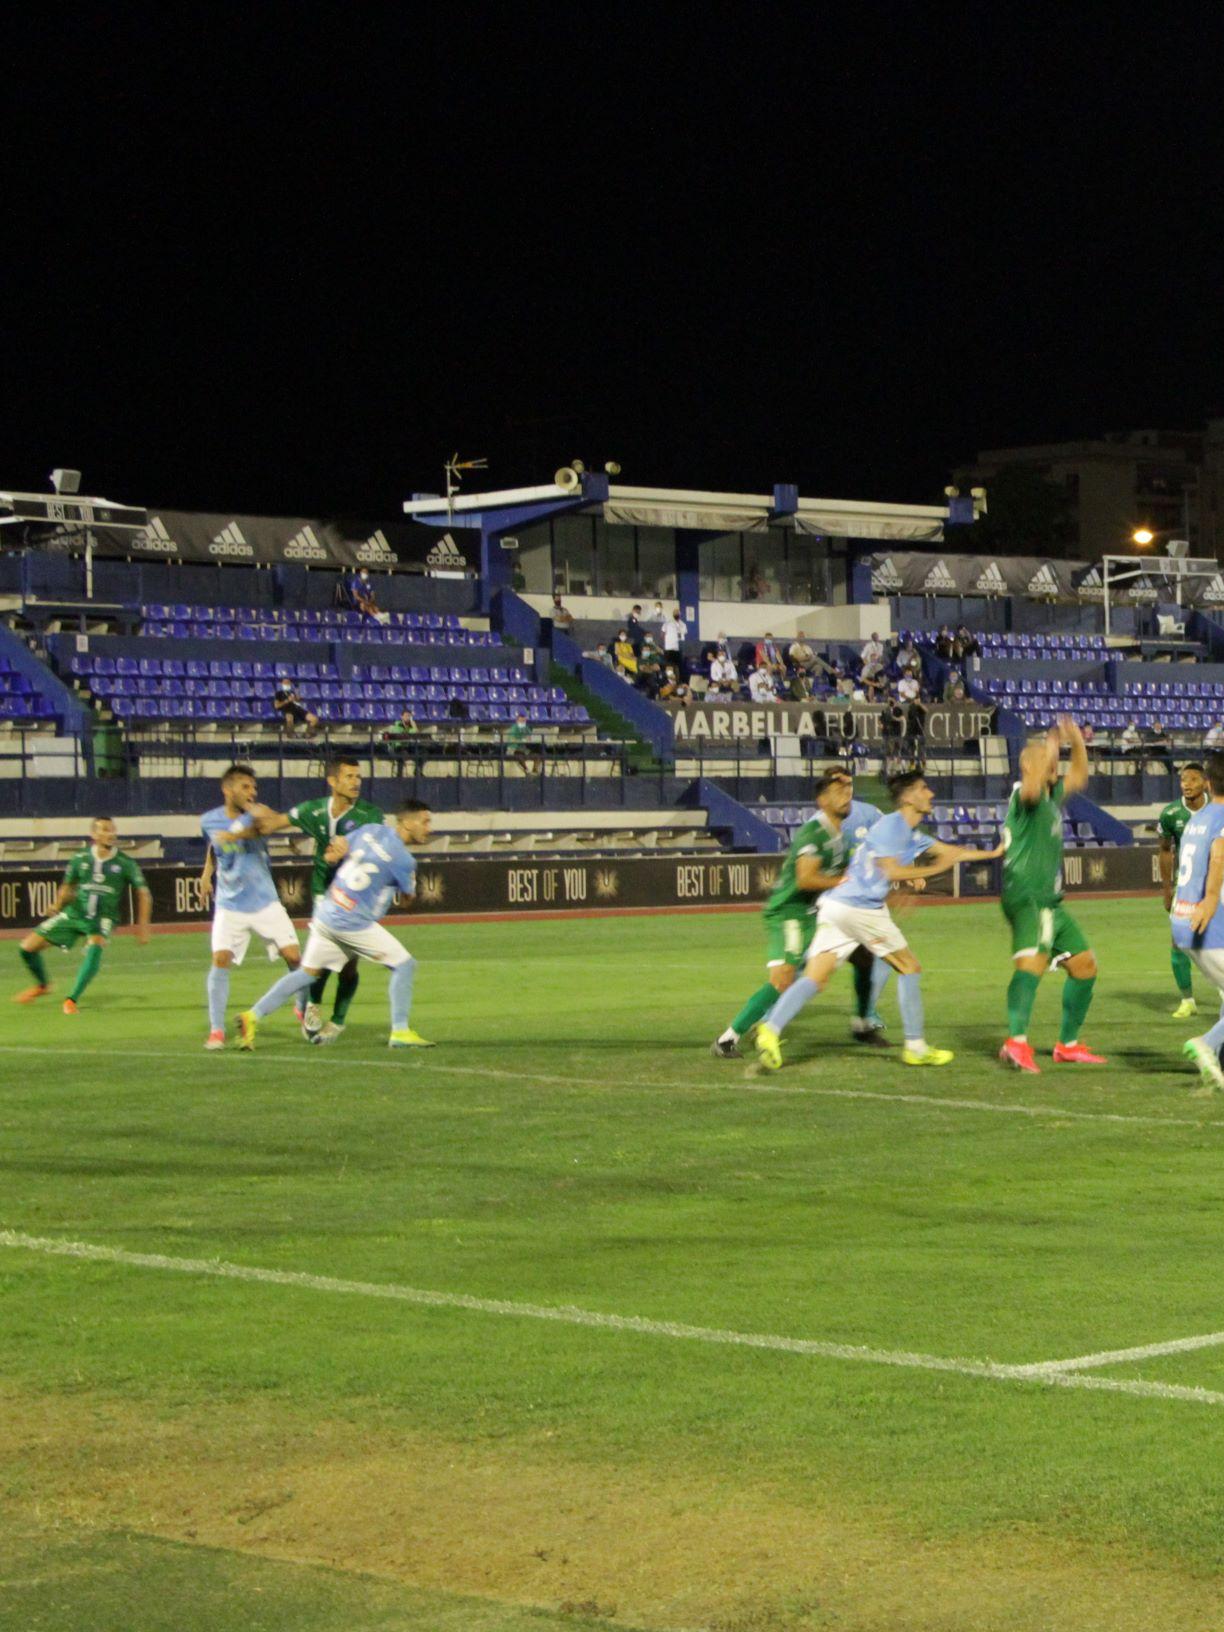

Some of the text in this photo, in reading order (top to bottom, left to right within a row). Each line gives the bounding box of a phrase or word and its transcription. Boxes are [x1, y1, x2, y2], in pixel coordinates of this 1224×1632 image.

[51, 535, 98, 549] adids
[132, 537, 178, 552] adidas
[209, 541, 254, 556] adidas
[284, 546, 327, 560] adidas
[356, 549, 398, 563] adidas
[426, 552, 467, 566] adidas
[924, 577, 956, 589] adidas
[976, 579, 1007, 591] adidas
[673, 710, 816, 740] MARBELLA
[929, 712, 992, 740] CLUB
[1064, 856, 1083, 885] YOU
[508, 868, 587, 901] BEST OF YOU
[677, 864, 750, 897] BEST OF YOU
[1, 881, 58, 918] OF YOU
